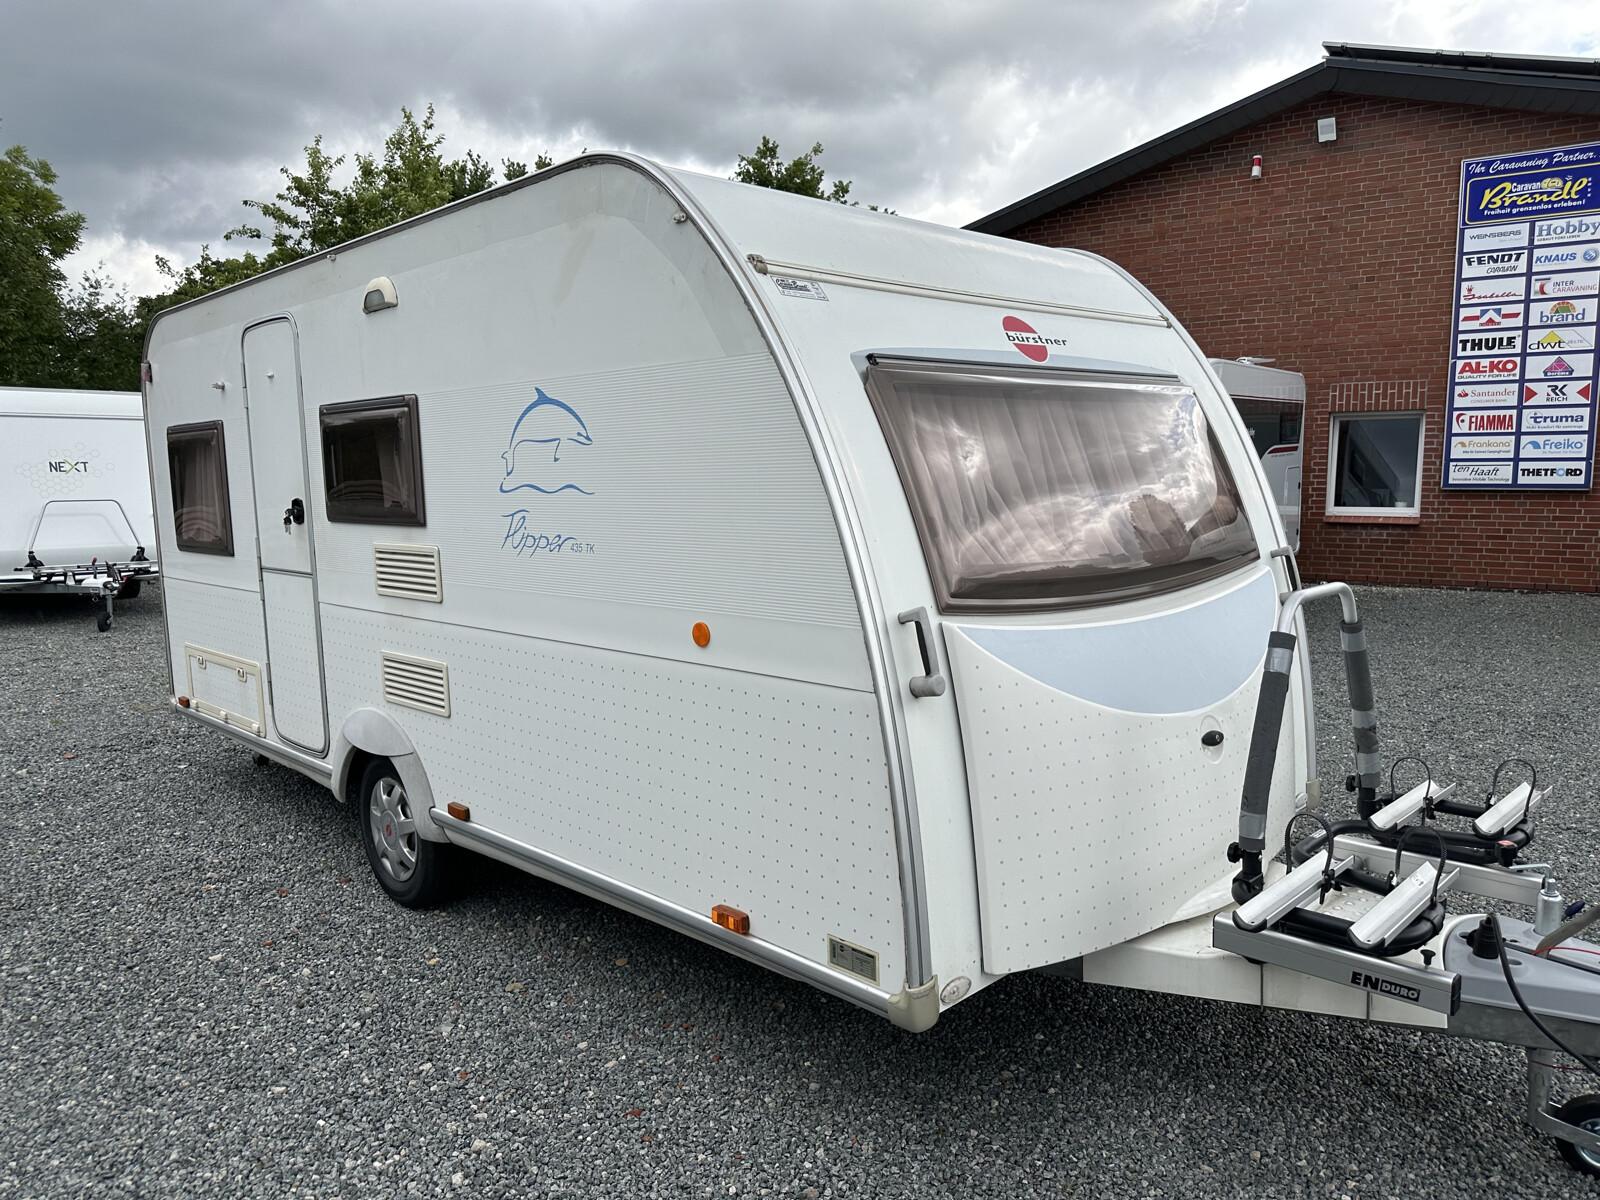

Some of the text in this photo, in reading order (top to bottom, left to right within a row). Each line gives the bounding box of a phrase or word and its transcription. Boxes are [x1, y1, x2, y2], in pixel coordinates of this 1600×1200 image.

[1469, 163, 1485, 174] Ihr
[1489, 158, 1548, 174] Caravaning
[1479, 177, 1588, 210] Brandl
[1511, 181, 1541, 192] Caravan
[1511, 203, 1552, 214] grenzenlos
[1553, 199, 1586, 208] erleben!
[1536, 219, 1600, 237] Hobby
[1465, 252, 1525, 266] FENDT
[1534, 252, 1577, 265] KNAUS
[1552, 284, 1597, 294] CARAVANING
[1540, 307, 1586, 323] brand
[1005, 331, 1067, 346] bürstner
[1459, 336, 1517, 352] THULE
[1528, 340, 1566, 350] dwt
[1458, 359, 1518, 375] AL-KO
[1470, 388, 1516, 397] Santander
[1468, 414, 1514, 431] FIAMMA
[1529, 412, 1584, 424] truma
[1468, 440, 1510, 448] Frankana
[1543, 438, 1583, 450] Freiko
[48, 459, 89, 475] NEXT
[1452, 463, 1500, 476] ten Haaft
[1520, 468, 1583, 477] THETFORD
[500, 509, 595, 558] Flipper 435 TK
